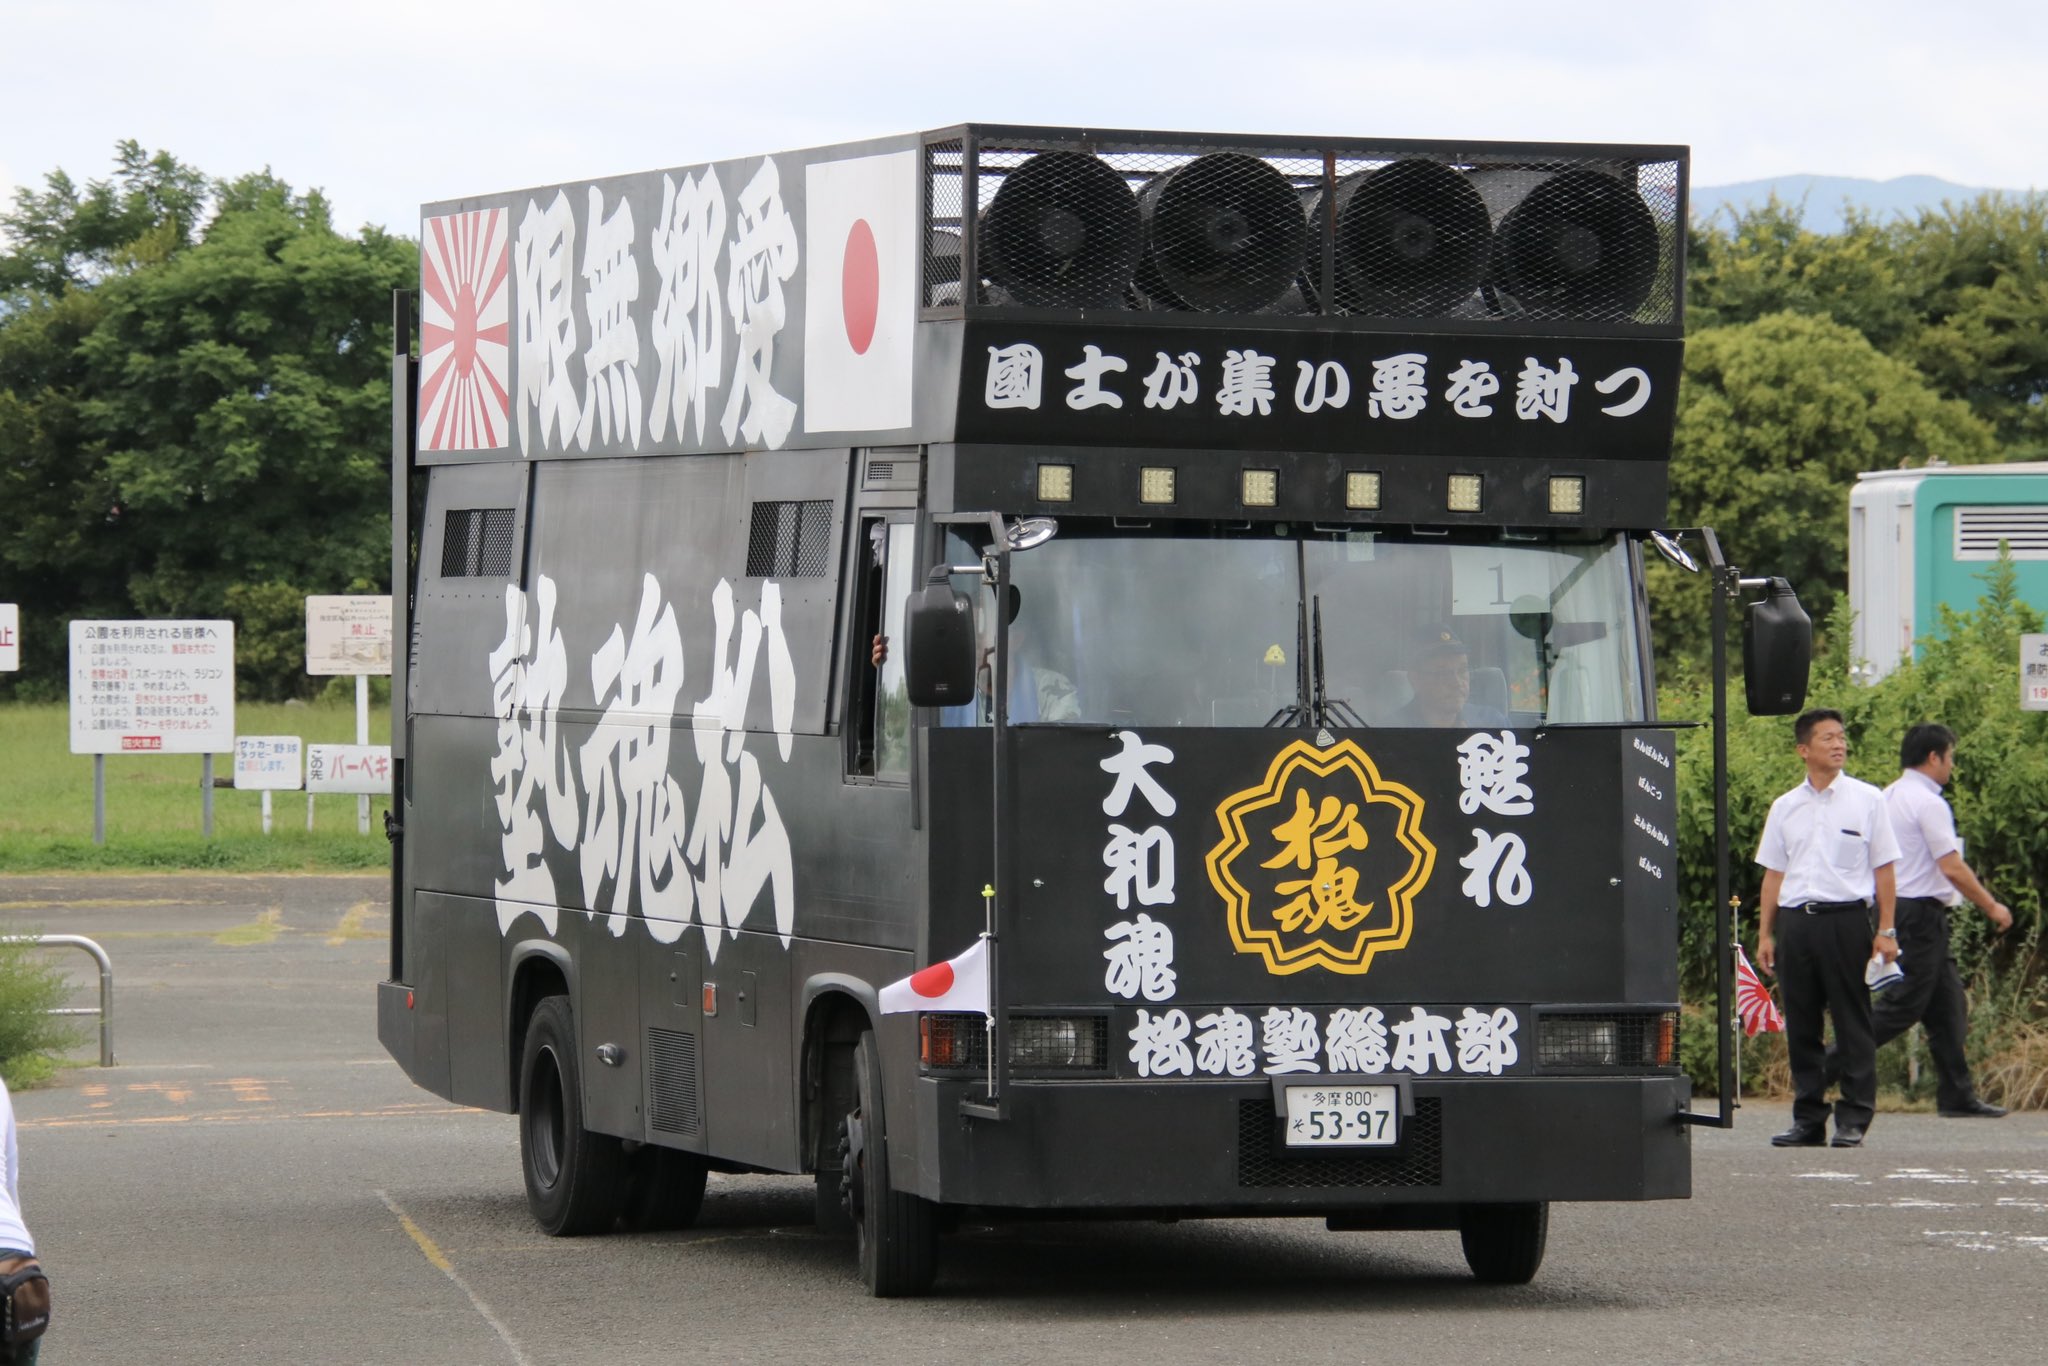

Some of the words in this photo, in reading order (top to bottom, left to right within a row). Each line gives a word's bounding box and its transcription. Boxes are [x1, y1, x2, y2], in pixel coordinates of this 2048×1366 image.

[984, 343, 1653, 423] 國士が集い悪を討つ
[1487, 563, 1513, 605] 1
[85, 626, 218, 639] 公園を利用される皆様へ
[352, 624, 376, 636] 禁止
[122, 737, 161, 749] 花火禁止
[310, 749, 324, 781] この先
[1456, 729, 1535, 908] 甦れ
[1099, 730, 1177, 1002] 大和魂
[1259, 787, 1375, 935] 松魂
[1128, 1006, 1520, 1077] 松魂塾総本部
[1312, 1091, 1342, 1106] 多摩
[1345, 1091, 1372, 1106] 800
[1292, 1118, 1305, 1133] そ
[1310, 1110, 1390, 1140] 53-97
